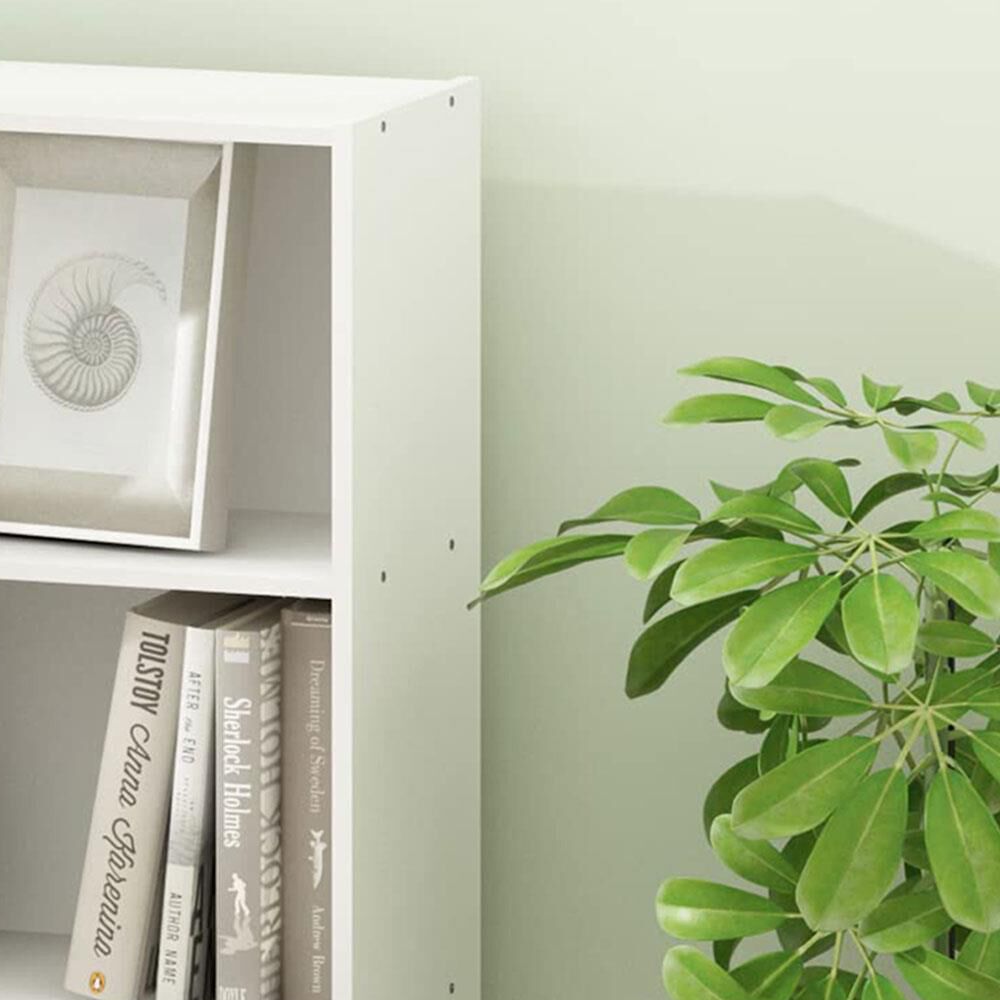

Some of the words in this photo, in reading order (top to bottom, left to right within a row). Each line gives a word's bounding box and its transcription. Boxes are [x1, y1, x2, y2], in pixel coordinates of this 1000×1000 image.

[130, 631, 170, 716] TOLSTOY
[185, 671, 202, 711] AFTER
[305, 660, 326, 732] Dreaming
[119, 723, 151, 809] Anna
[181, 737, 196, 764] END
[223, 697, 252, 775] Sherlock
[309, 736, 326, 752] of
[309, 754, 326, 814] Sweden
[223, 783, 252, 848] Holmes
[93, 817, 136, 958] Karenina
[166, 892, 182, 942] AUTHOR
[162, 949, 177, 985] NAME
